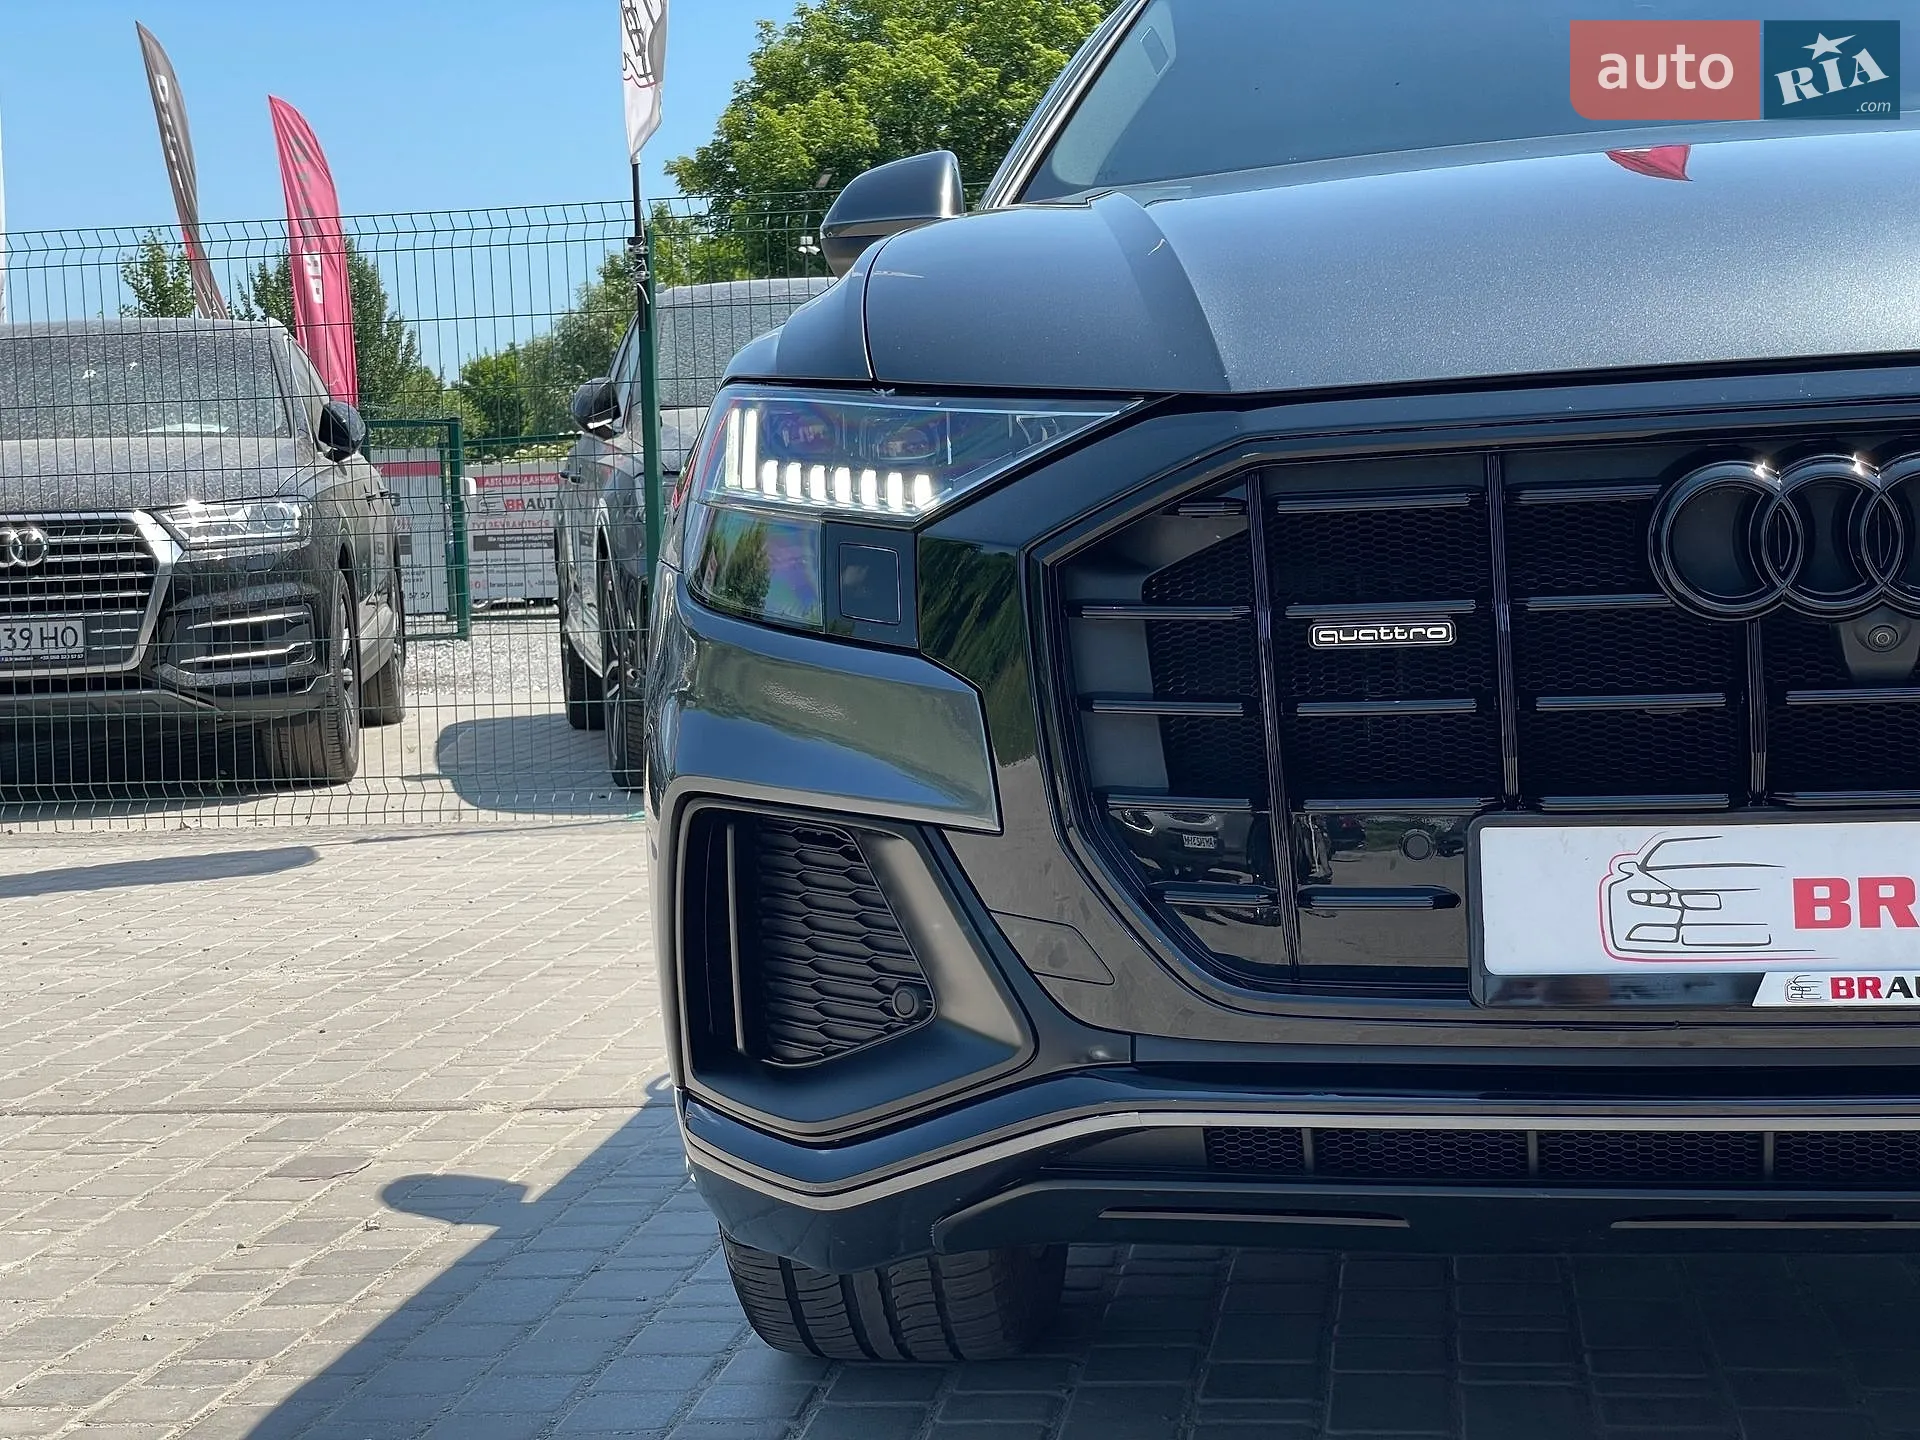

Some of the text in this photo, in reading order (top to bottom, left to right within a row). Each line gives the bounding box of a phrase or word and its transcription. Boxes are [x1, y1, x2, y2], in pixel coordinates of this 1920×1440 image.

[0, 626, 79, 651] 39 HO
[1318, 626, 1447, 643] quattro
[1792, 876, 1920, 930] BR
[1830, 976, 1920, 1000] BRA
